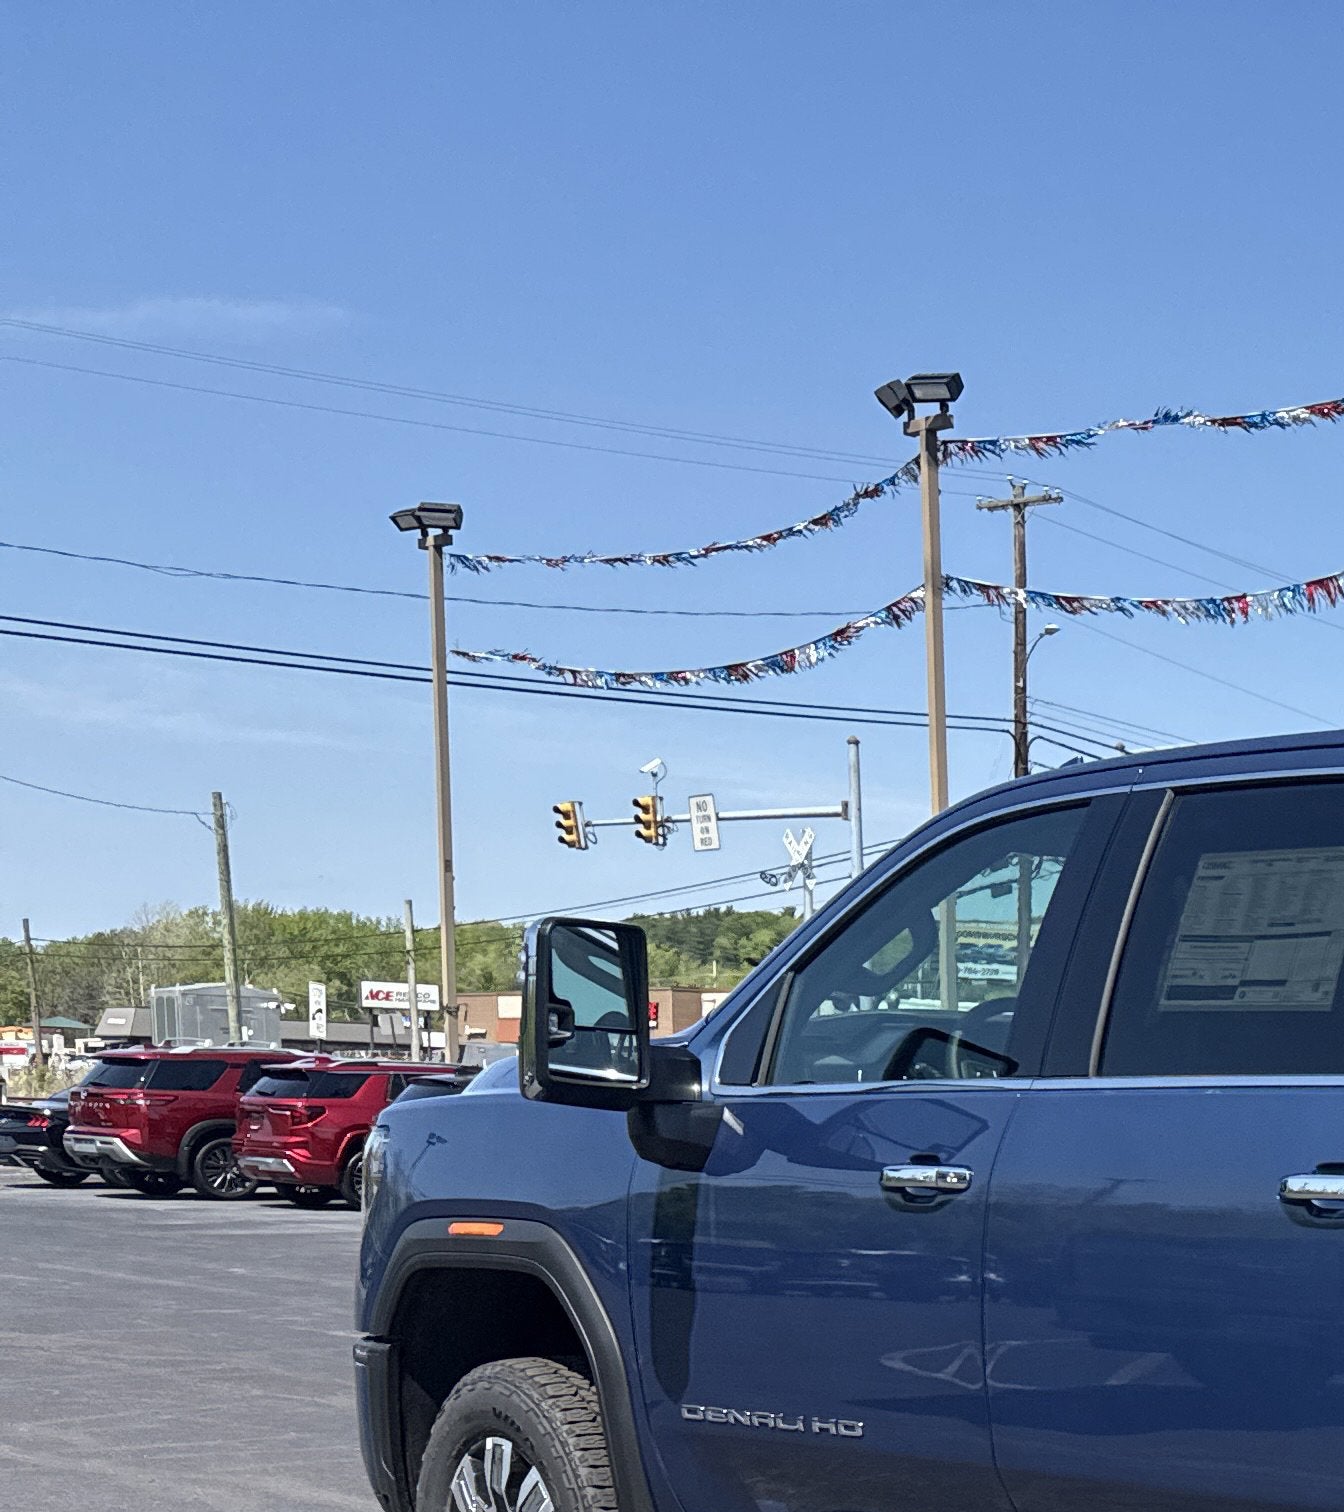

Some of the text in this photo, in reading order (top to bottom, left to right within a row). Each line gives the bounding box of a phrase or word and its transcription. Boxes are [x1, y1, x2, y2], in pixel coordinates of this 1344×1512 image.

[696, 800, 708, 813] NO
[696, 814, 711, 824] TURN
[699, 826, 710, 835] ON
[699, 836, 713, 847] RED
[365, 989, 394, 1001] ACE
[680, 1403, 864, 1438] DENALI HD
